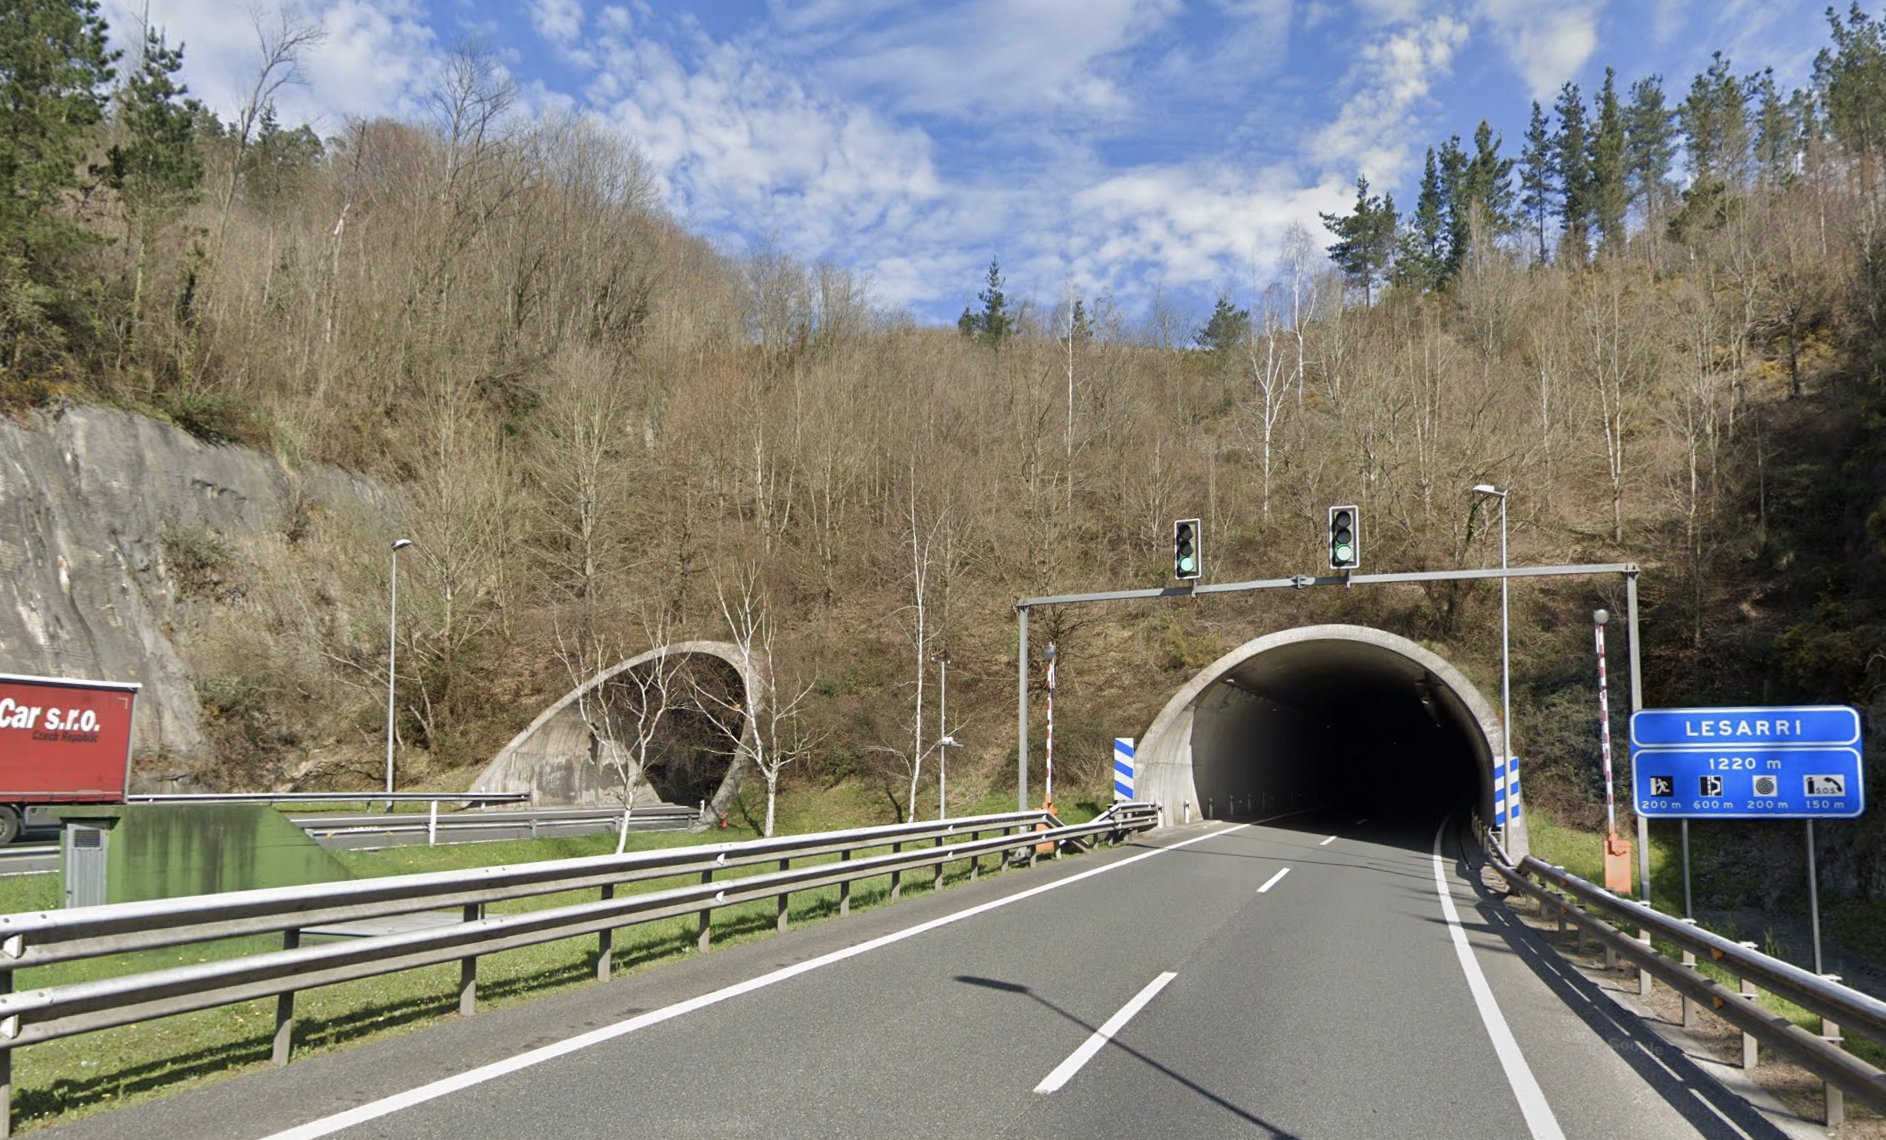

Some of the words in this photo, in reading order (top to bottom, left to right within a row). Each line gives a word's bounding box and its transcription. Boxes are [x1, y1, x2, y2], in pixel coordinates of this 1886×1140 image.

[0, 698, 42, 729] Car
[44, 707, 100, 732] s.r.o.
[1686, 720, 1801, 736] LESARRI
[1709, 758, 1756, 770] 1220
[1767, 759, 1782, 769] m
[1642, 800, 1668, 809] 200
[1693, 800, 1719, 809] 600
[1747, 800, 1774, 809] 200
[1806, 800, 1830, 809] 150
